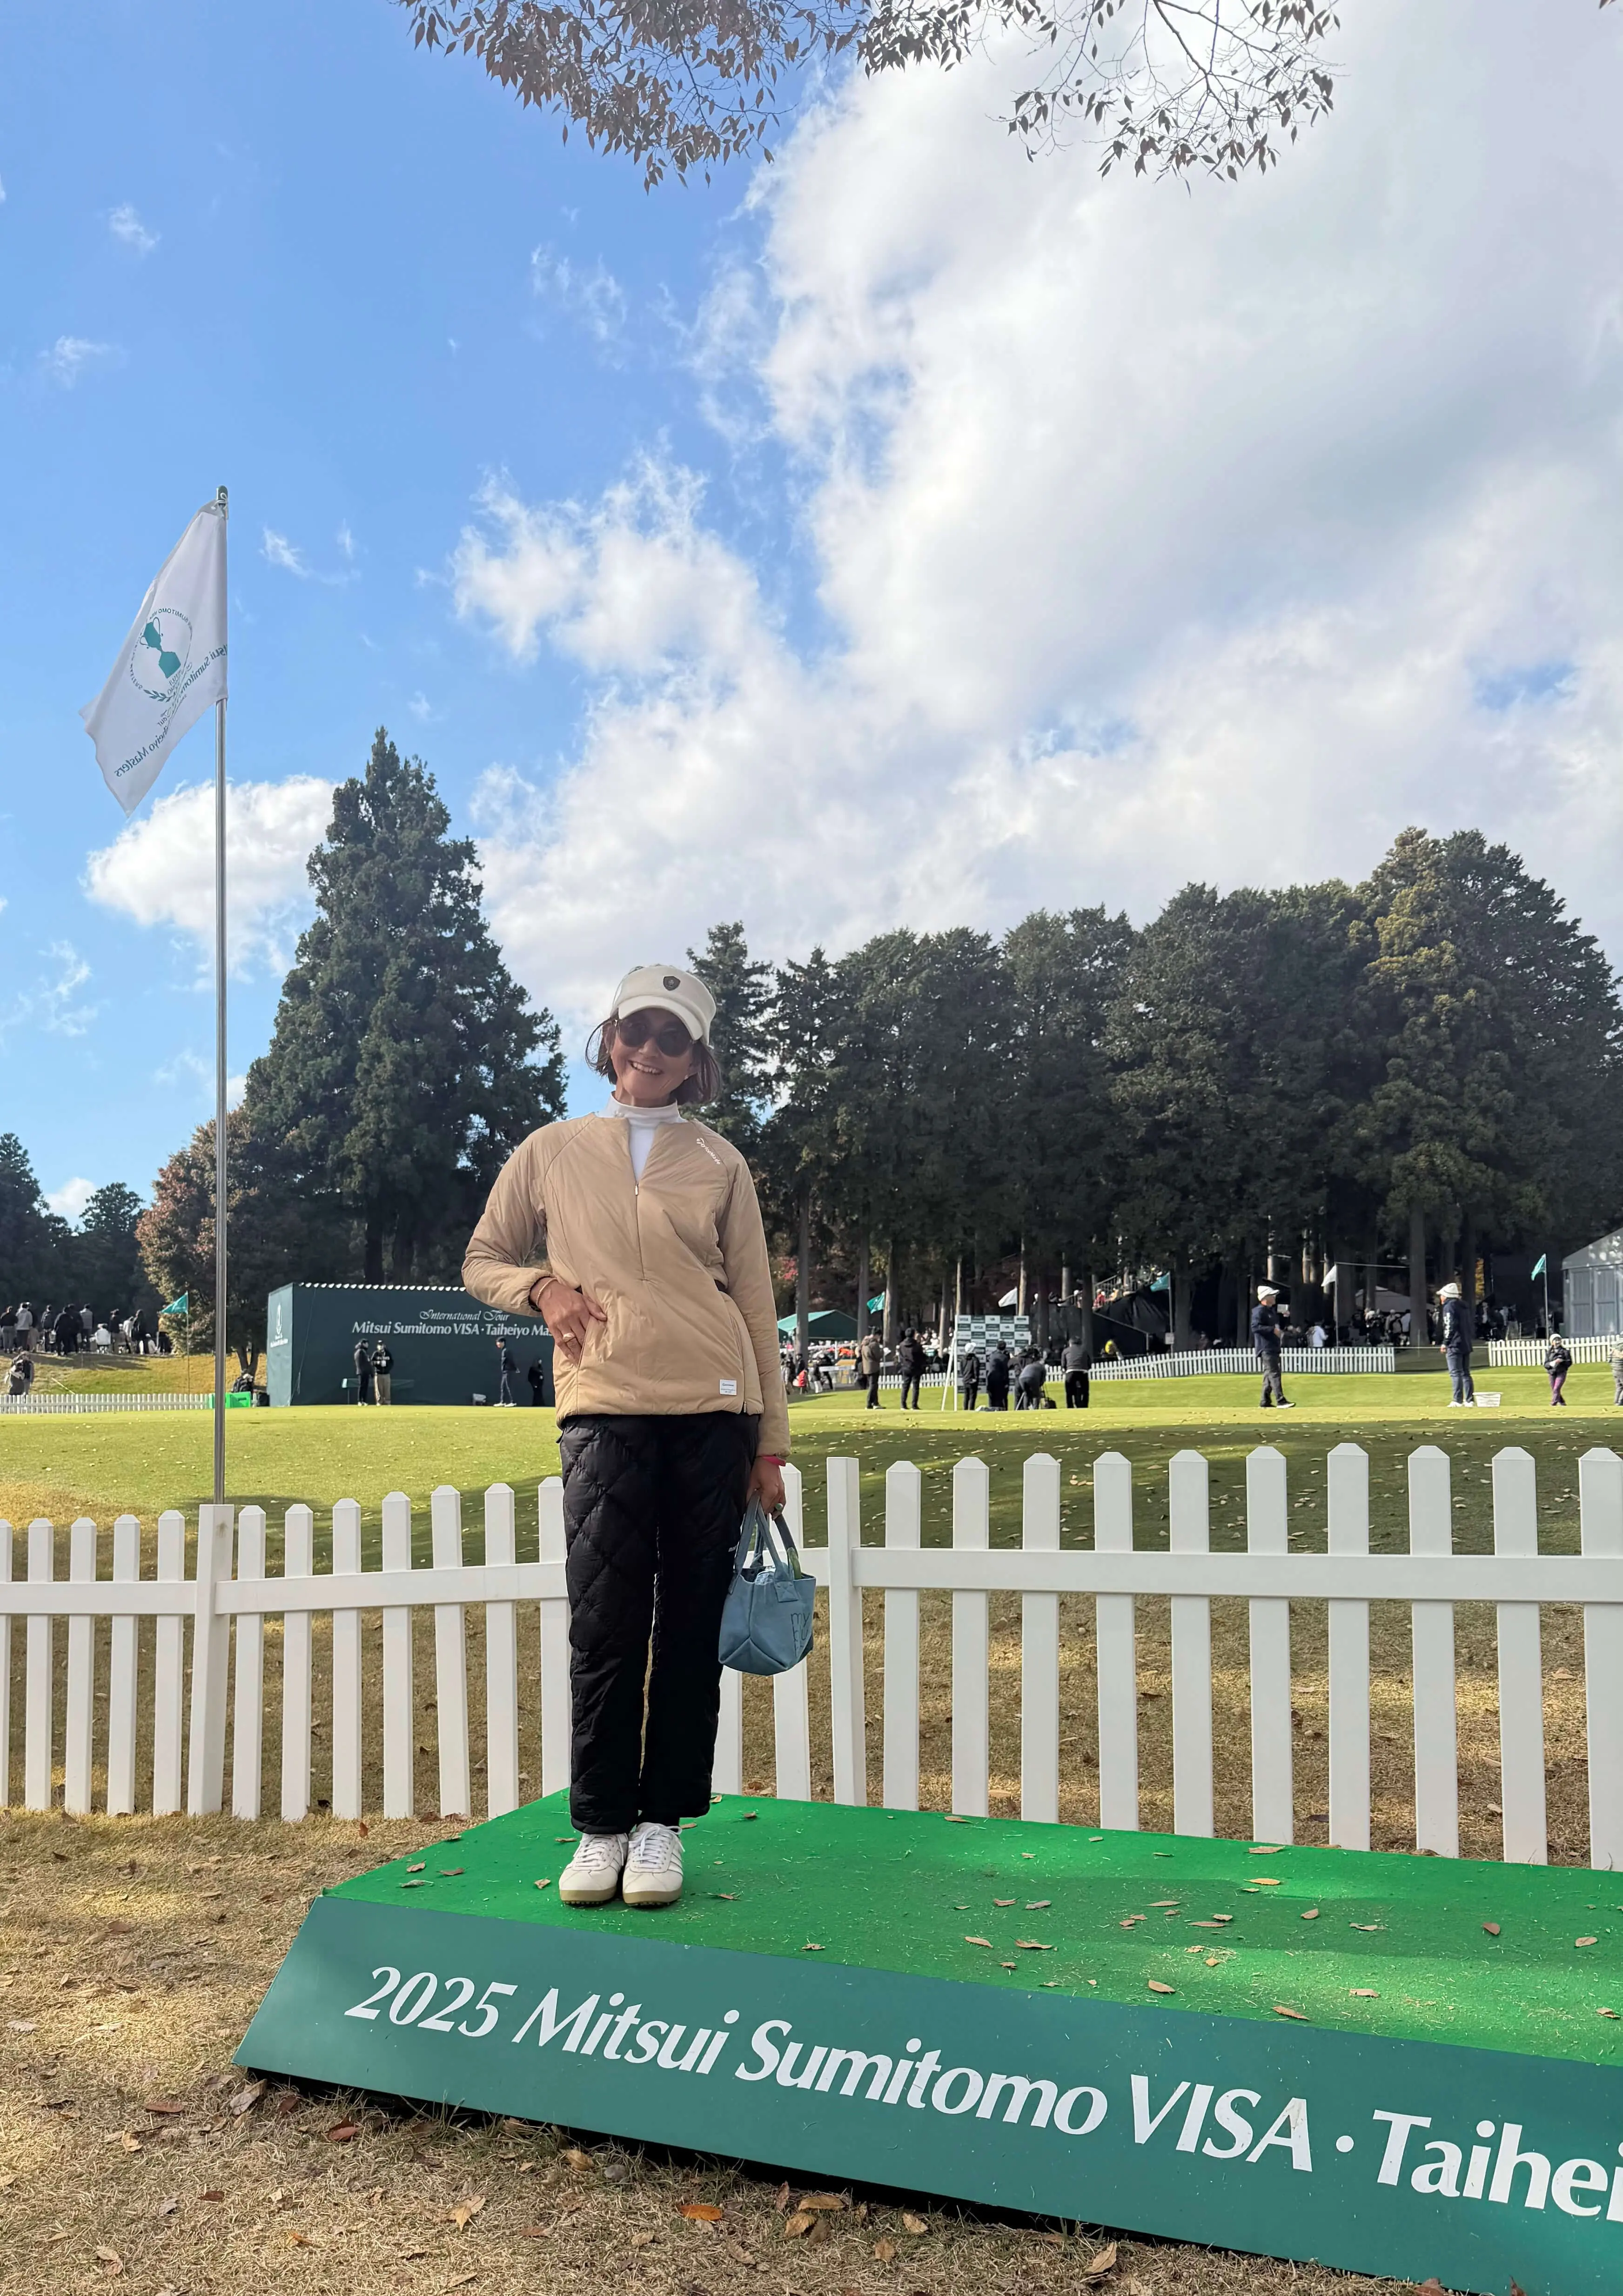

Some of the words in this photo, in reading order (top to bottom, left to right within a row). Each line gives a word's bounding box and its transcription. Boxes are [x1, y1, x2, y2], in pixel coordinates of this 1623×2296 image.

[419, 1309, 481, 1320] International
[483, 1310, 510, 1321] Tour
[352, 1321, 392, 1333] Mitsui
[393, 1322, 451, 1334] Sumitomo
[453, 1323, 480, 1334] VISA
[485, 1324, 530, 1339] Taiheiyo
[344, 1967, 517, 2036] 2025
[512, 1988, 740, 2075] Mitsui
[735, 2020, 1107, 2135] Sumitomo
[1131, 2074, 1312, 2172] VISA
